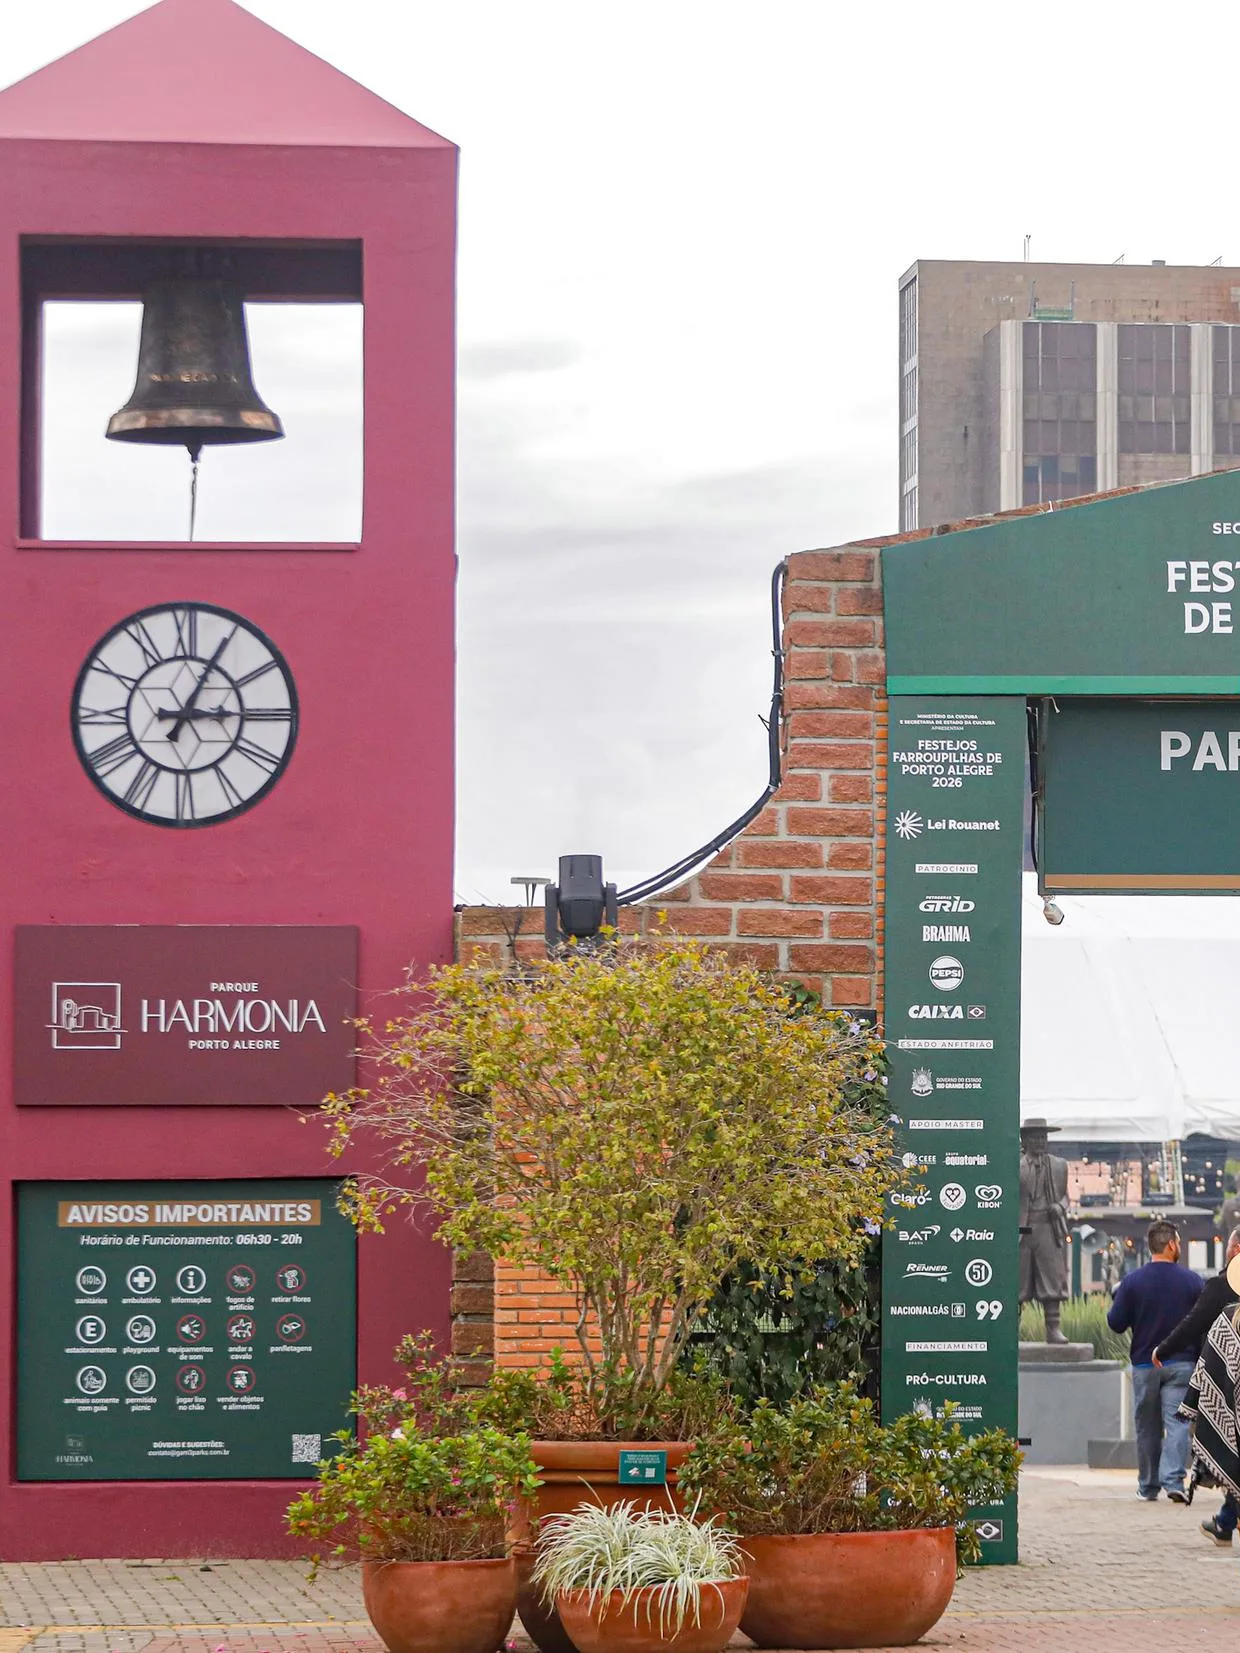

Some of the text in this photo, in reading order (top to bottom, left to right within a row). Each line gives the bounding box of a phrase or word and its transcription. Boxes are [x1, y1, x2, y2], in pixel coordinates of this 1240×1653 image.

[1184, 602, 1233, 634] DE
[918, 740, 977, 750] FESTEJOS
[893, 752, 1002, 763] FARROUPILHAS DE
[902, 765, 993, 775] PORTO ALEGRE
[932, 778, 962, 788] 2026
[928, 820, 1000, 830] Lei Rouanet
[923, 926, 970, 942] BRAHMA
[932, 969, 961, 977] PEPSI
[210, 982, 259, 992] PARQUE
[141, 999, 326, 1033] HARMONIA
[908, 1005, 964, 1019] CAIXA
[189, 1040, 280, 1049] PORTO ALEGRE
[68, 1203, 312, 1223] AVISOS IMPORTANTES
[81, 1234, 302, 1246] Horário de Funcionamento: 06h30 20h
[899, 1231, 931, 1241] BAT
[966, 1230, 994, 1241] Raia
[972, 1265, 986, 1281] 51
[891, 1304, 949, 1315] NACIONALGÁS
[975, 1300, 1003, 1320] 99
[906, 1373, 987, 1385] PRÓ-CULTURA
